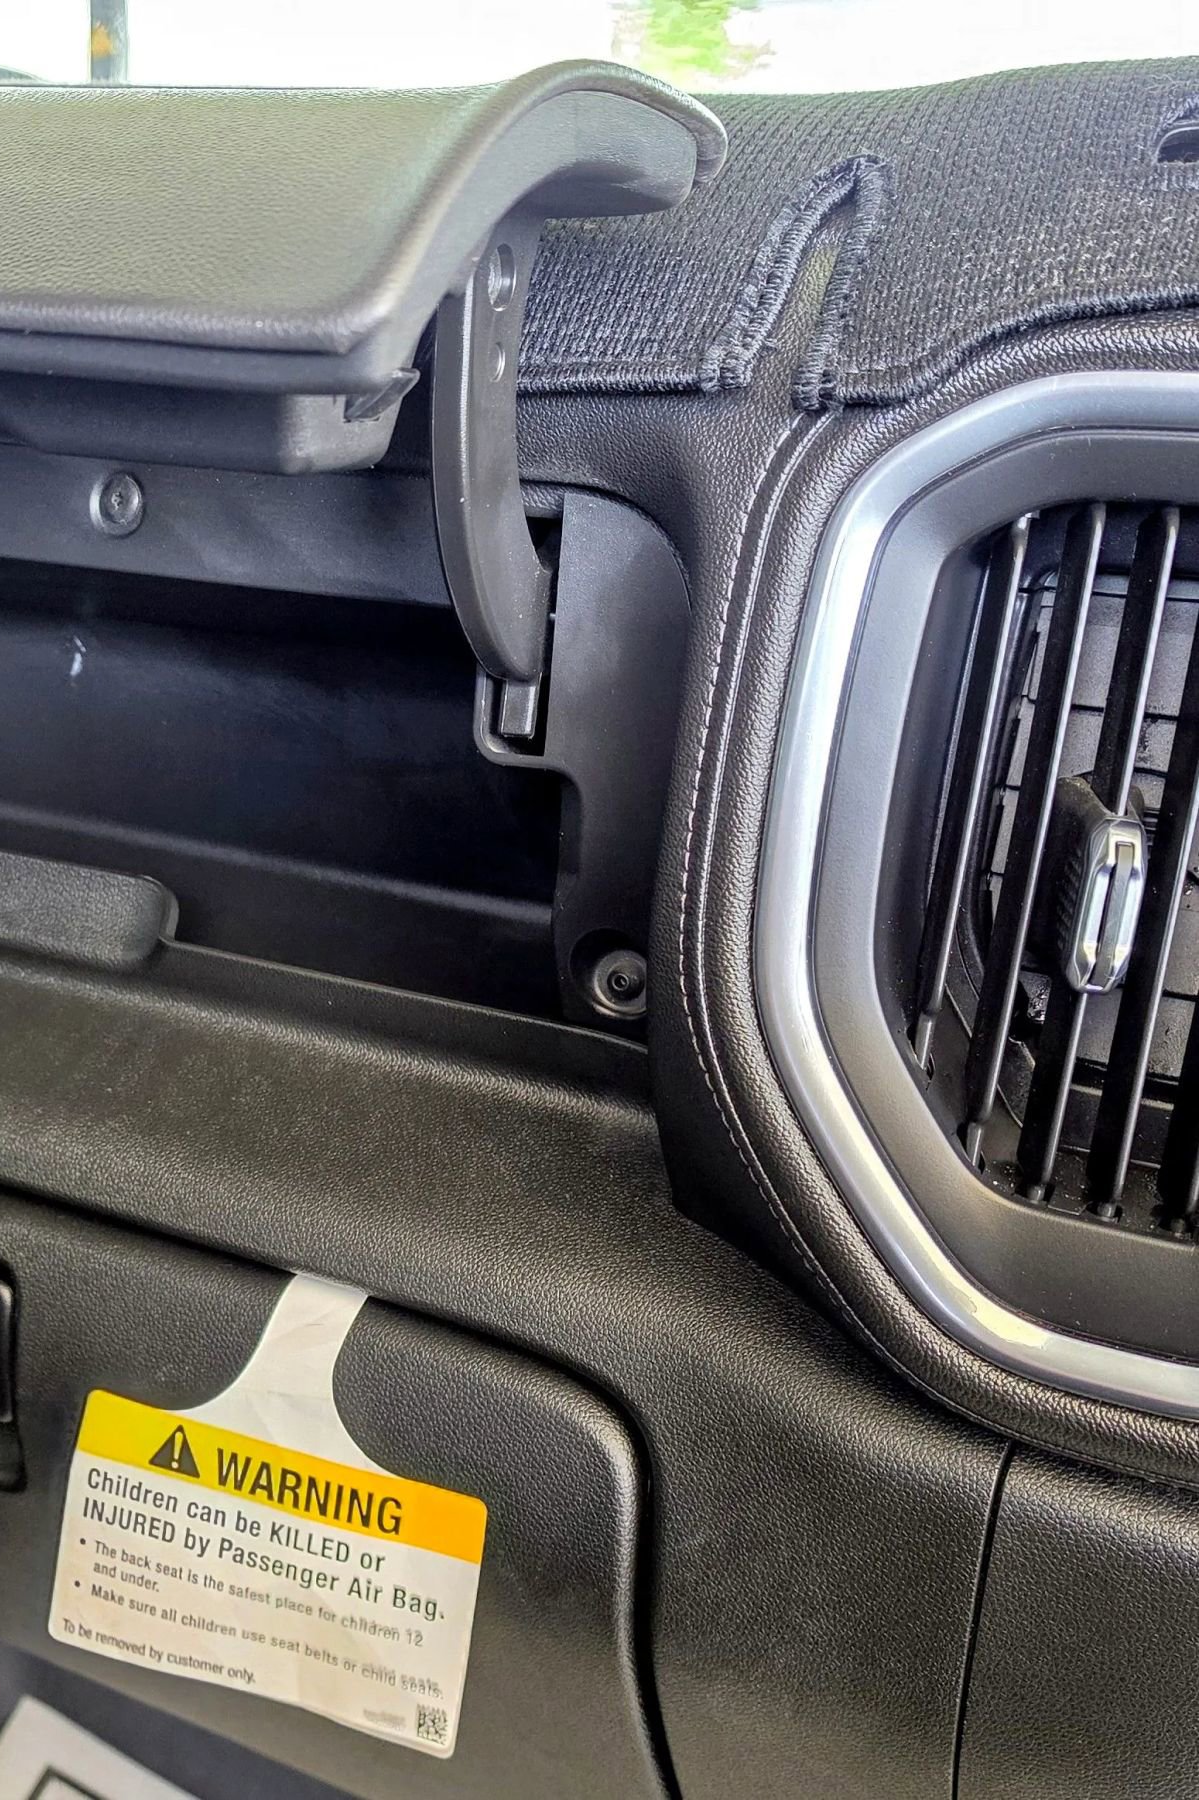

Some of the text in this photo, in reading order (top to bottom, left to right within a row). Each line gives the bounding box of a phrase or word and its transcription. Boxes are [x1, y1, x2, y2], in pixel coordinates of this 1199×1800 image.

[88, 1468, 386, 1572] Children can be KILLED or
[217, 1448, 402, 1535] WARNING
[83, 1497, 445, 1621] INJURED by Passenger Air Bag.
[93, 1562, 160, 1593] and under.
[94, 1540, 424, 1647] The back seat is the safest place for children 12
[63, 1618, 256, 1684] To be removed by customer only.
[91, 1583, 125, 1606] Make
[128, 1598, 157, 1616] sure
[161, 1608, 177, 1623] all
[181, 1613, 237, 1637] children
[241, 1629, 266, 1644] use
[270, 1636, 300, 1653] seat
[305, 1644, 338, 1667] belts
[343, 1658, 358, 1672] or
[361, 1664, 397, 1687] child
